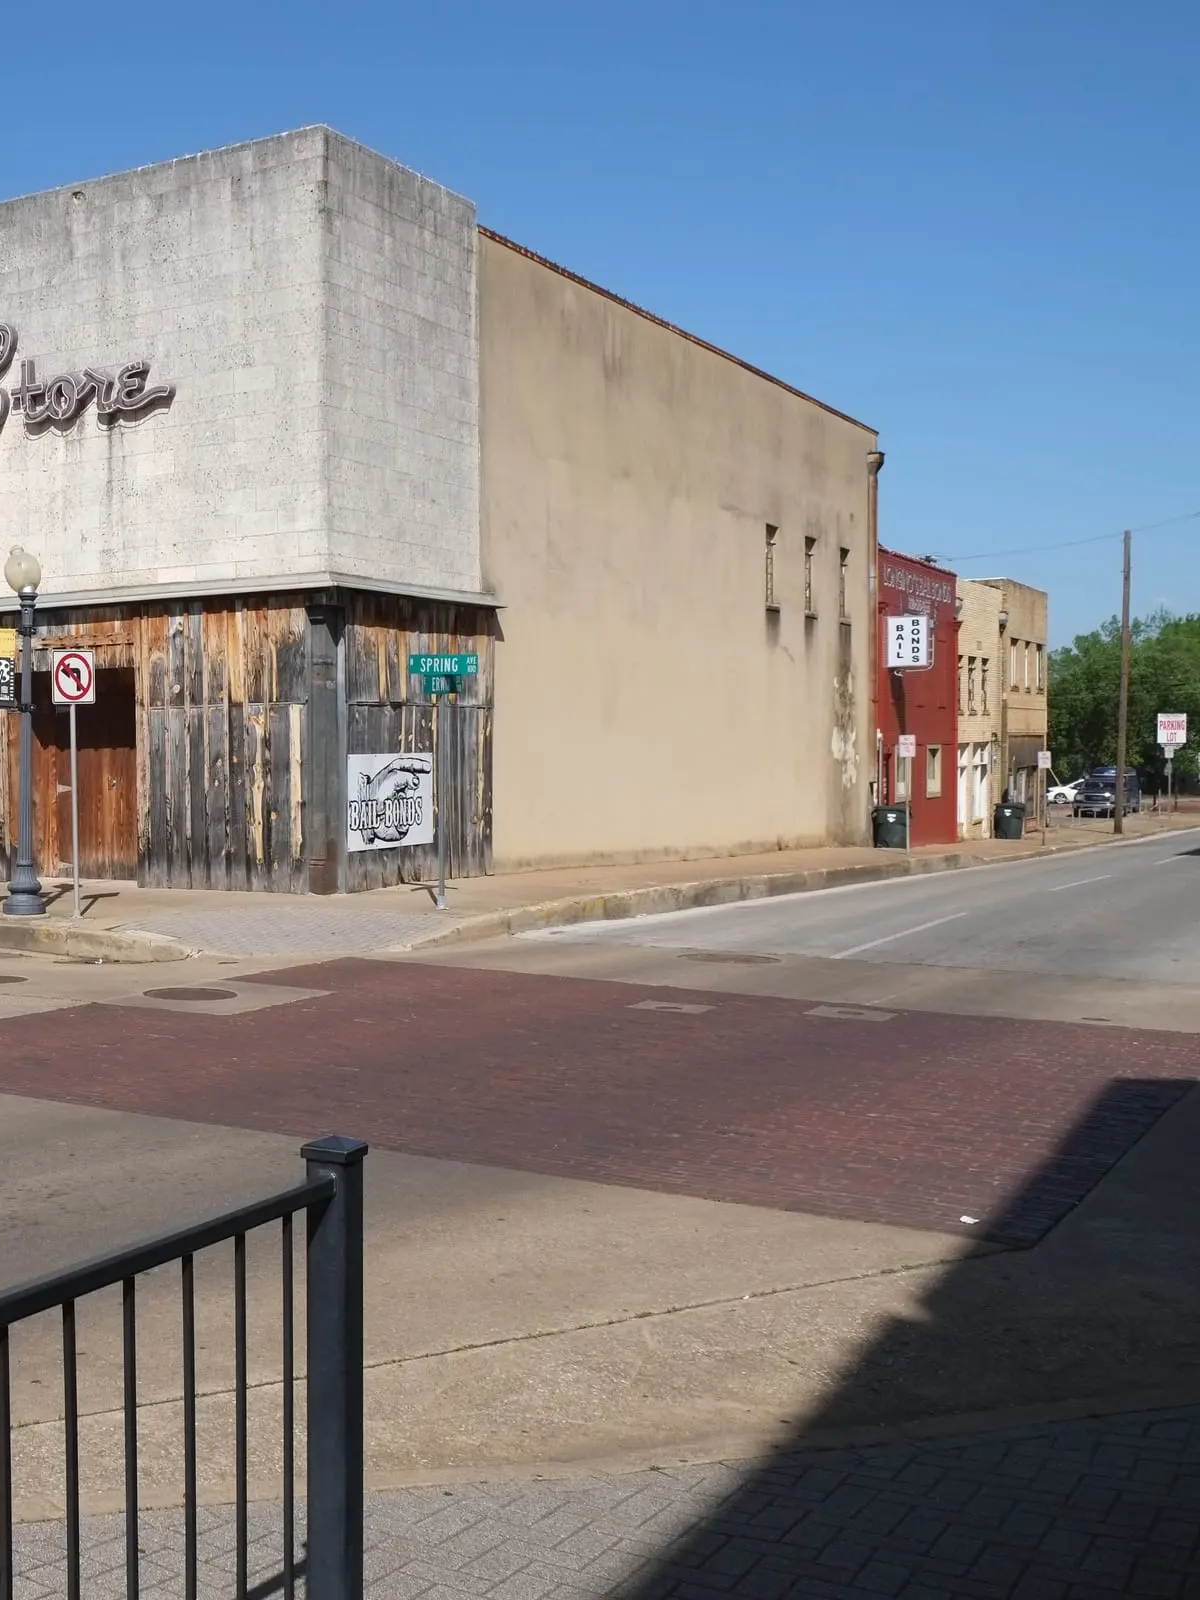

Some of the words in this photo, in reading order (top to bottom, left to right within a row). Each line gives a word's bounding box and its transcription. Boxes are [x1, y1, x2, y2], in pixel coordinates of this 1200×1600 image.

[896, 624, 904, 659] BAIL
[911, 619, 920, 663] BONDS
[420, 657, 458, 673] SPRING
[466, 656, 477, 665] AVE
[1159, 720, 1185, 731] PARKING
[1166, 731, 1177, 742] LOT
[349, 800, 380, 831] BAIL
[384, 796, 423, 828] BONDS
